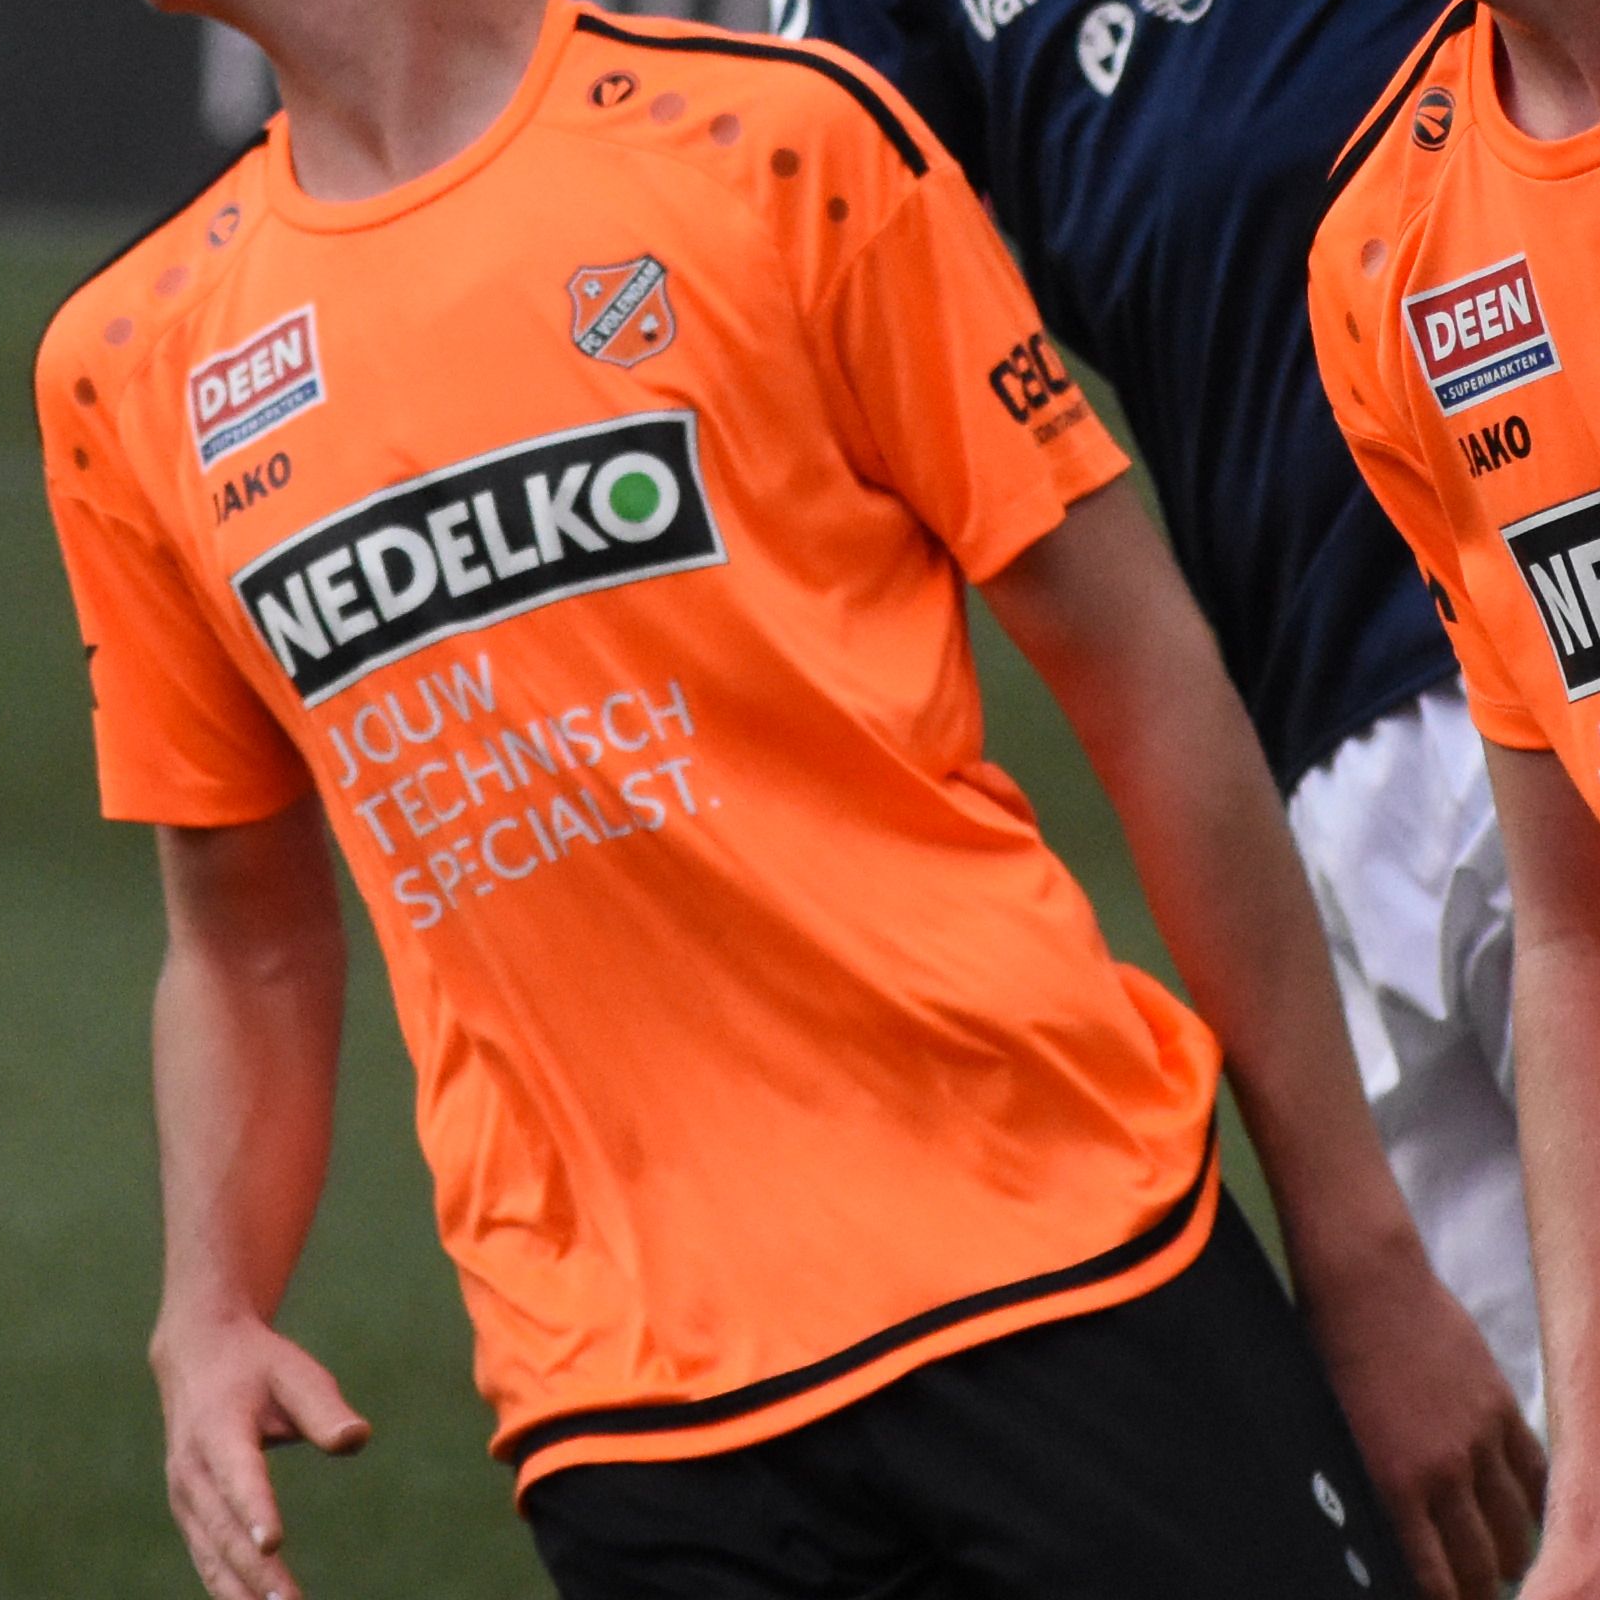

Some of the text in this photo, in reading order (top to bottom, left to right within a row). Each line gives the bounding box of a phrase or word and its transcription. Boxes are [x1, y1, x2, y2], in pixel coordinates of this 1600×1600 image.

[199, 329, 303, 422] DEEN
[1425, 277, 1532, 362] DEEN
[1448, 353, 1538, 400] SUPERMARKTEN
[255, 451, 681, 679] NEDELKO
[327, 651, 498, 789] JOUW
[353, 679, 696, 857] TECHNISCH
[392, 757, 720, 930] SPECIALST.
